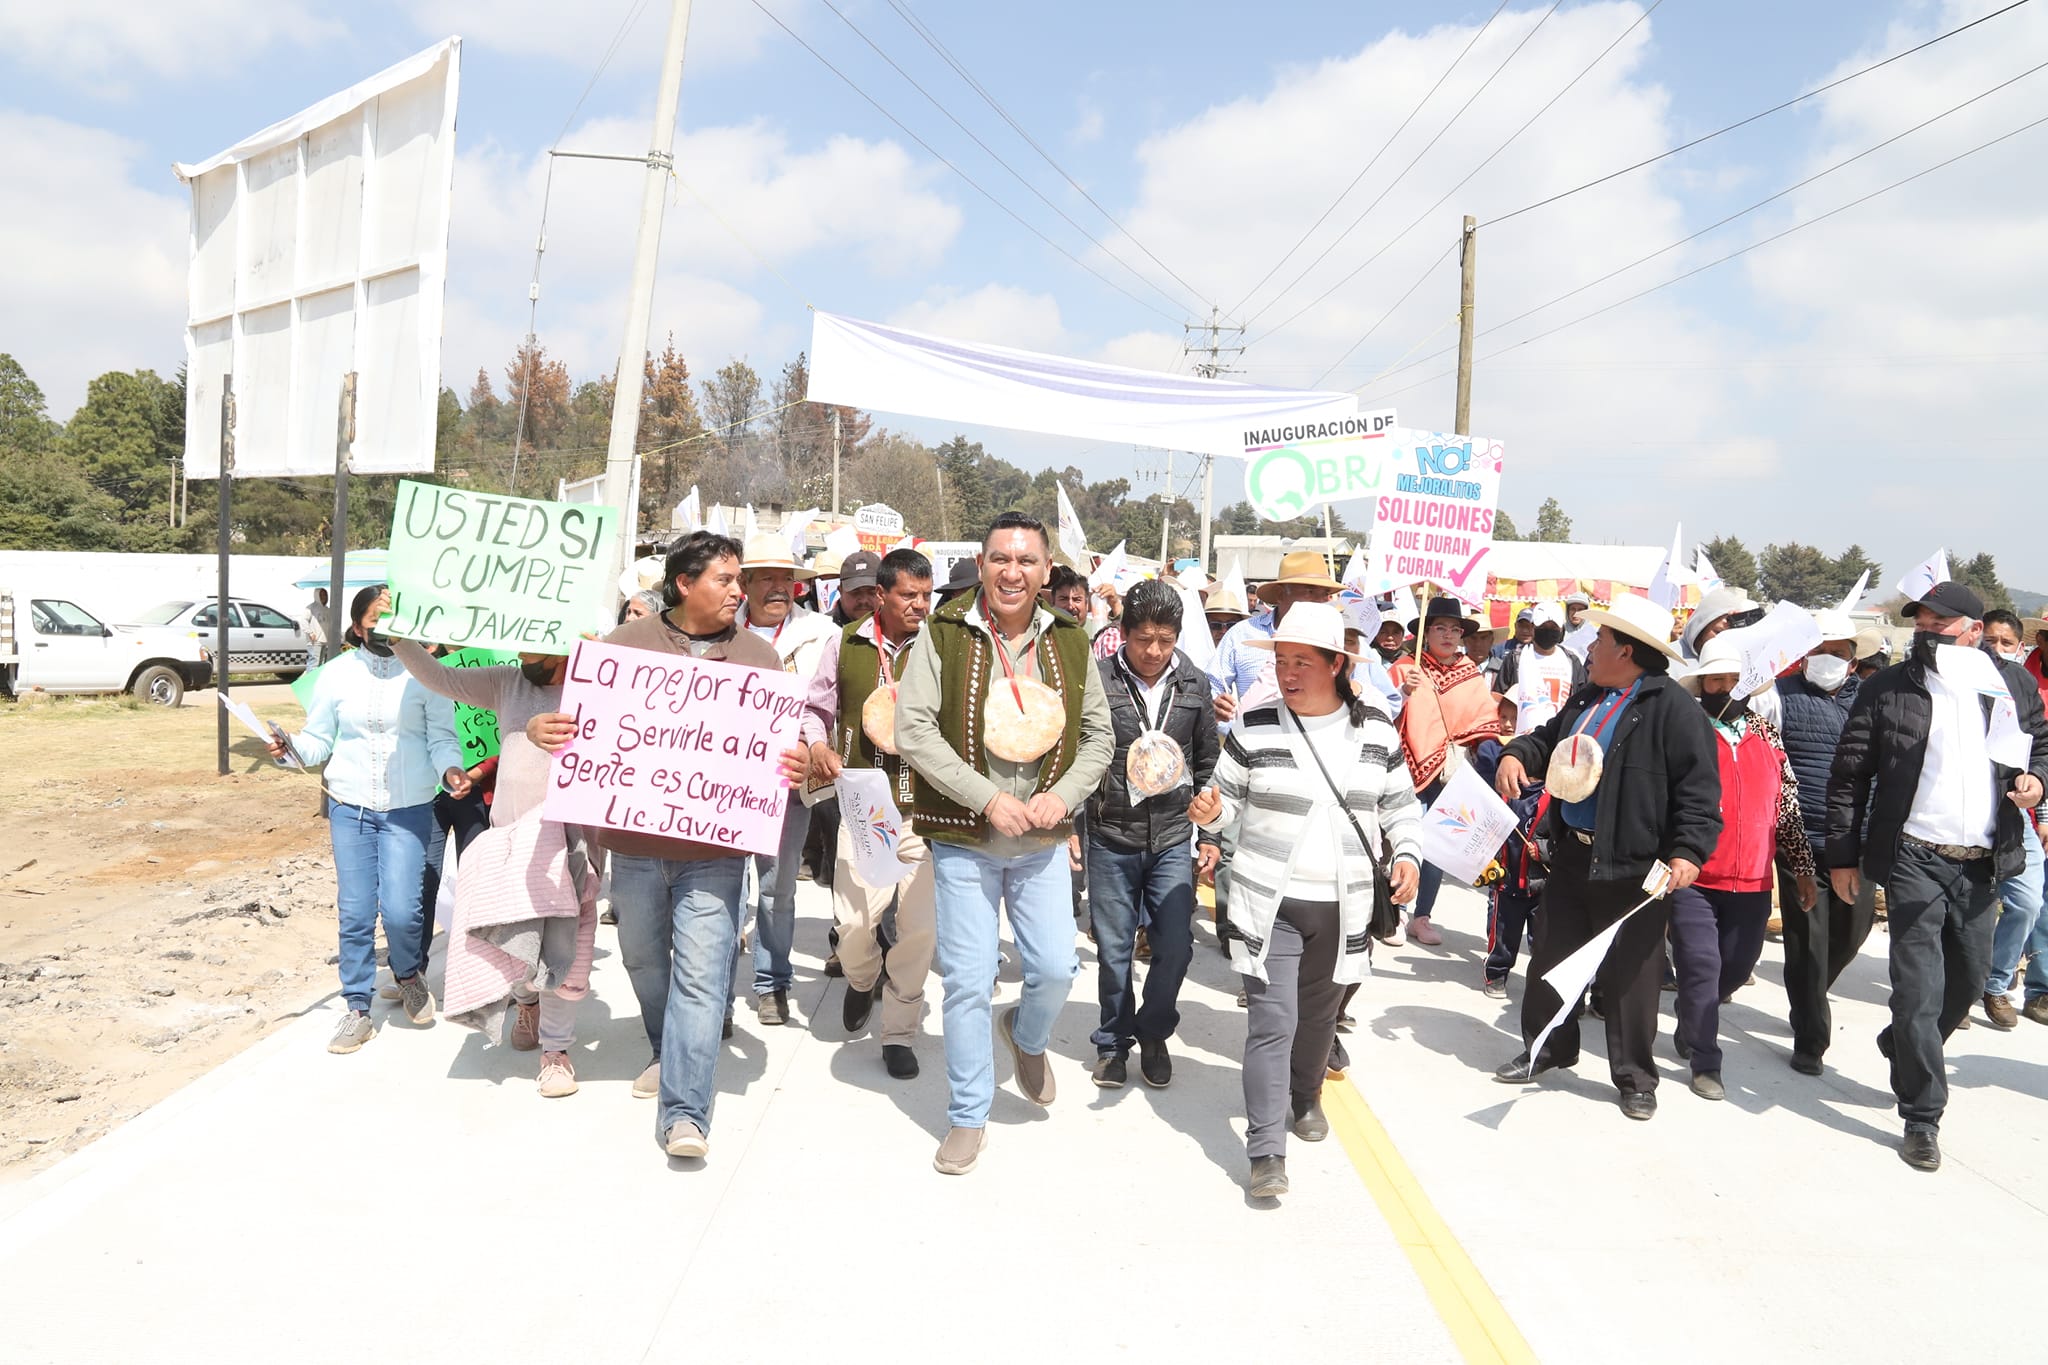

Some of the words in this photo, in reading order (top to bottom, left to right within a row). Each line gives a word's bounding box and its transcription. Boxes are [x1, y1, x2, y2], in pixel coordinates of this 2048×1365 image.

[1244, 417, 1368, 446] INAUGURACIÓN
[1415, 443, 1473, 476] NO!
[1396, 473, 1482, 501] MEJORALITOS
[405, 486, 549, 550] USTED
[559, 508, 603, 561] SI
[859, 513, 874, 525] SAN
[875, 515, 898, 529] FELIPE
[1377, 496, 1493, 534] SOLUCIONES
[1393, 530, 1421, 551] QUE
[1424, 534, 1471, 557] DURAN
[433, 546, 584, 603] CUMPLE
[1385, 554, 1393, 573] Y
[449, 605, 566, 645] JAVIER.
[571, 641, 619, 689] La
[631, 667, 732, 714] mejor
[738, 671, 805, 734] forma
[616, 713, 713, 751] Servirle
[722, 736, 740, 756] a
[745, 733, 768, 762] la
[557, 752, 636, 789] gente
[650, 768, 682, 795] es
[604, 794, 654, 828] Lic.
[658, 803, 744, 846] Javier.
